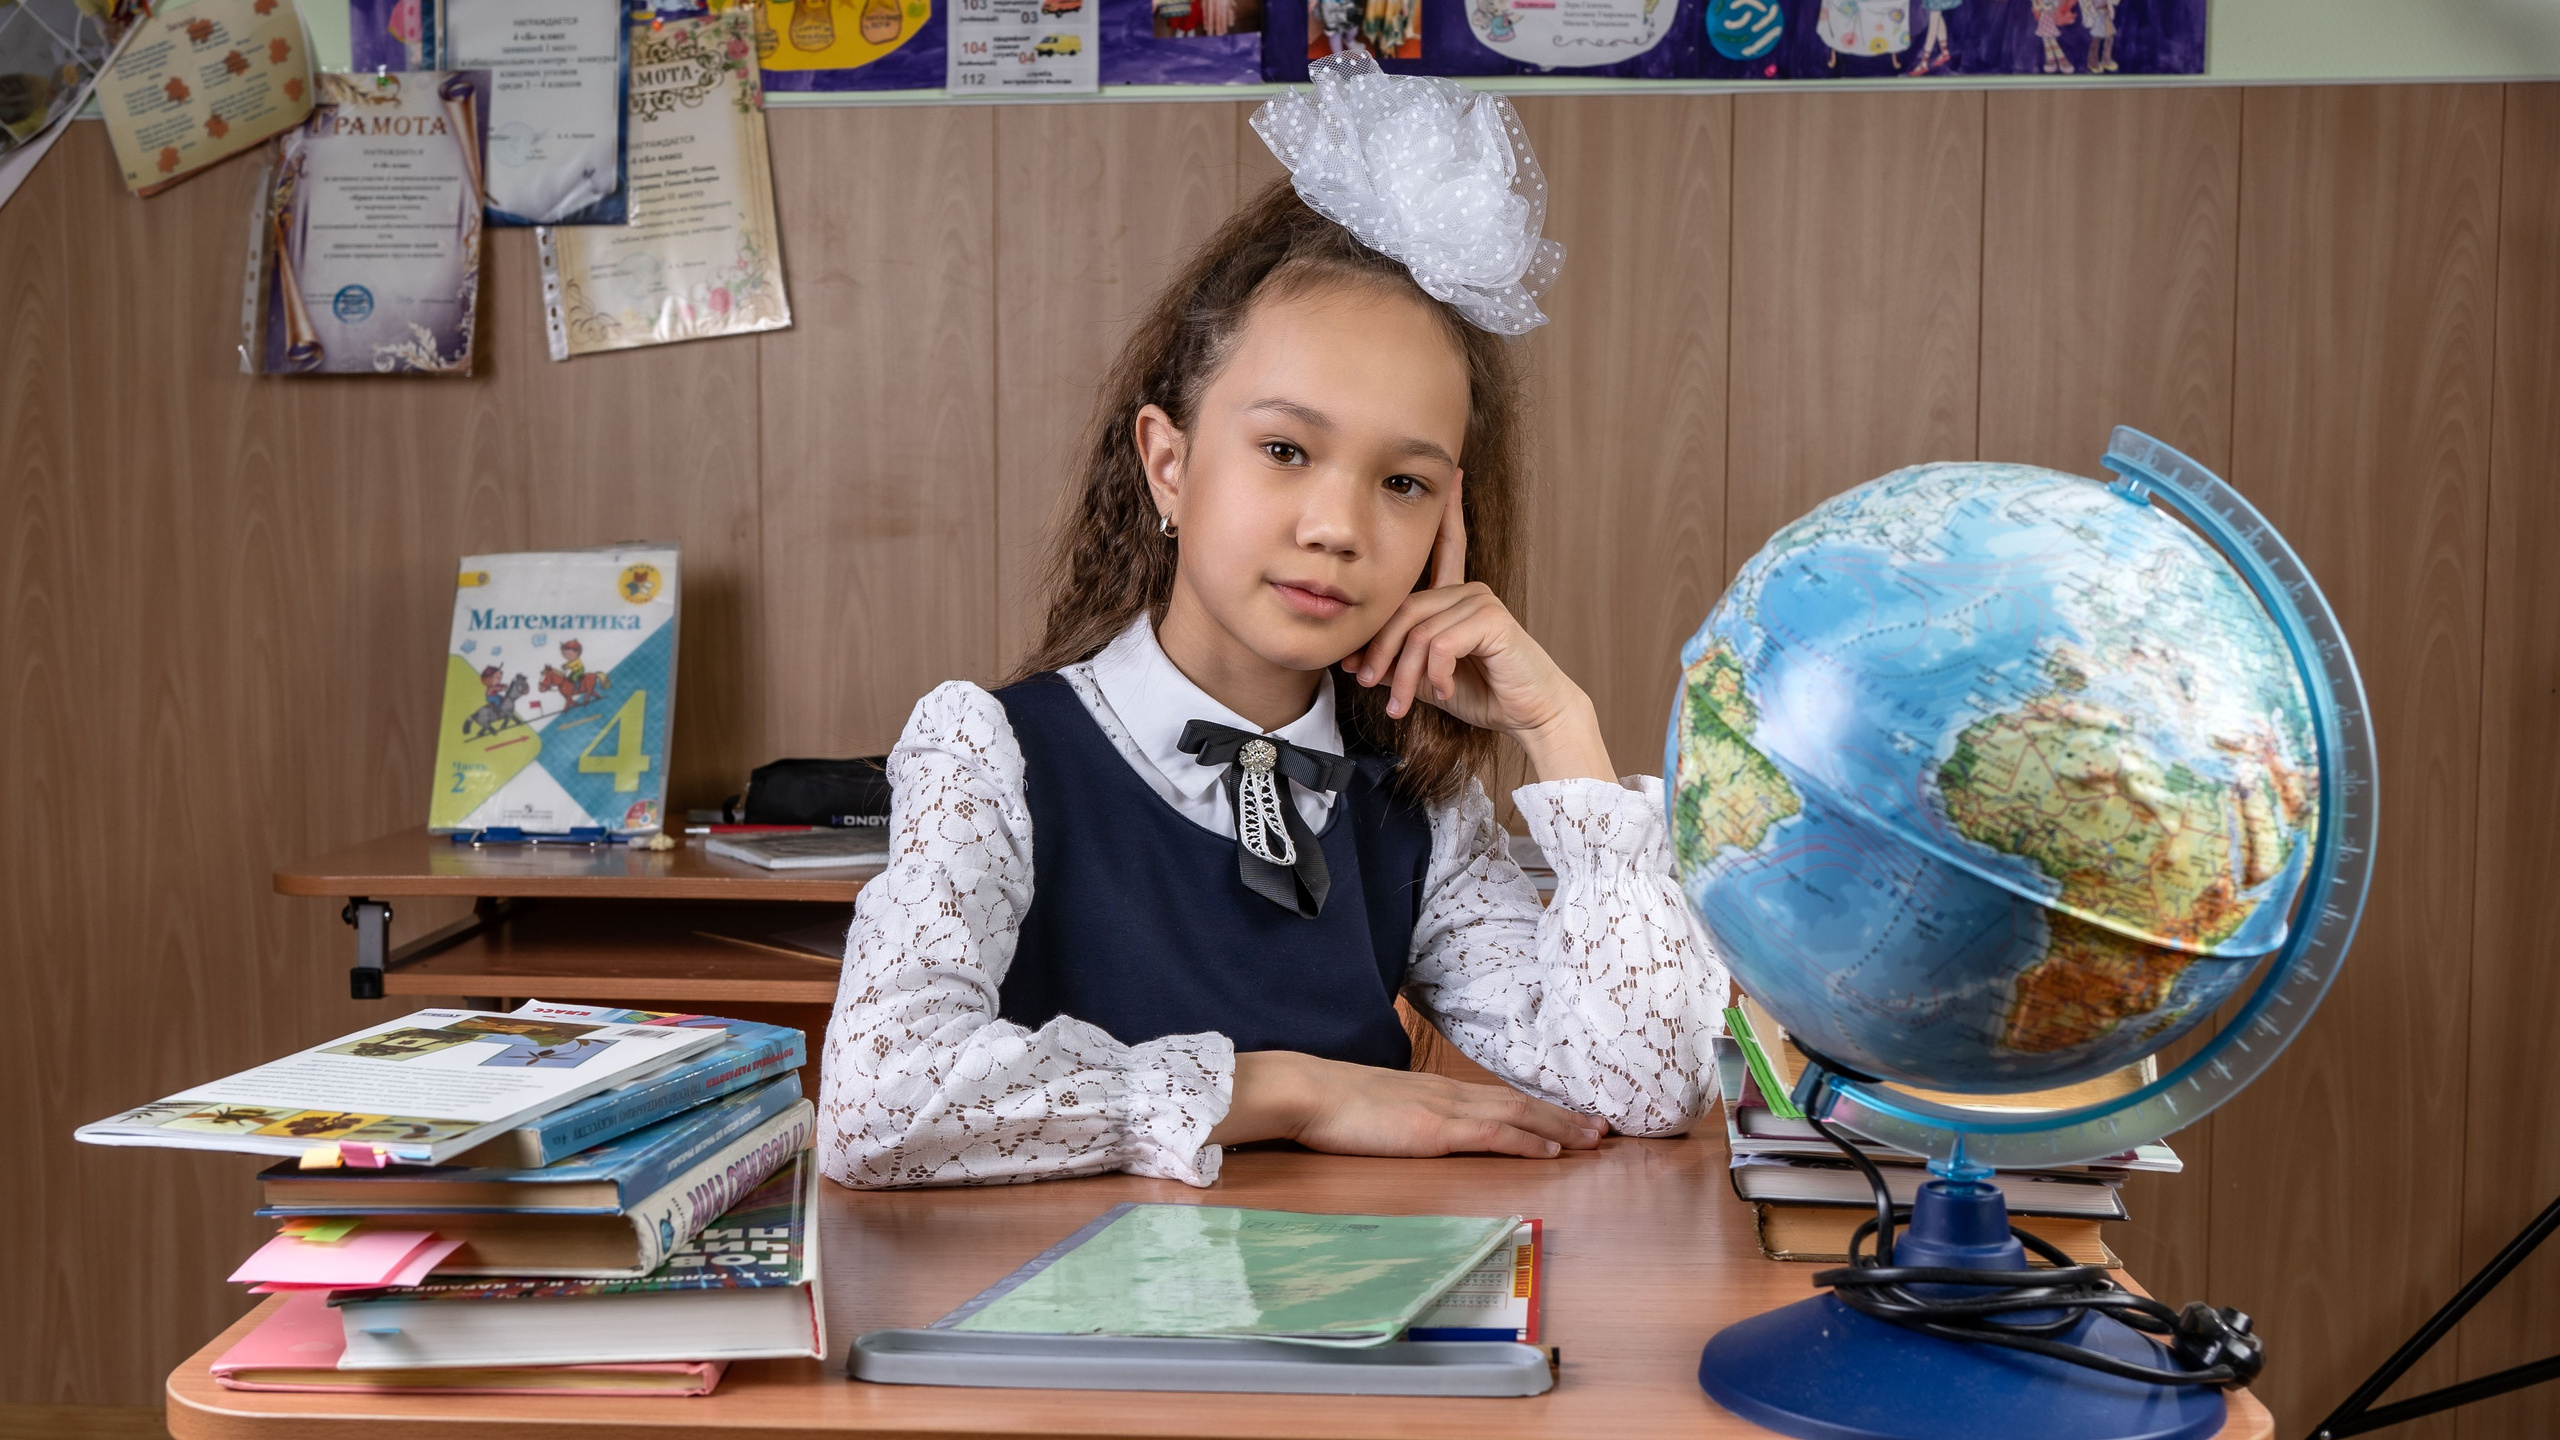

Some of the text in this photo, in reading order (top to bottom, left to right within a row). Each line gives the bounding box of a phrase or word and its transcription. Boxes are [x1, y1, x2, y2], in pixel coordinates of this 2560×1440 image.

[1020, 11, 1039, 24] 03
[962, 41, 988, 55] 104
[1018, 51, 1037, 64] 04
[961, 73, 986, 86] 112
[312, 106, 448, 136] ГРАМОТА
[467, 607, 642, 631] Математика
[578, 689, 650, 793] 4
[450, 772, 467, 794] 2
[532, 1006, 592, 1018] КЛАСС
[705, 1063, 752, 1090] РАЗРАБОТКИ
[686, 1174, 726, 1241] МИР
